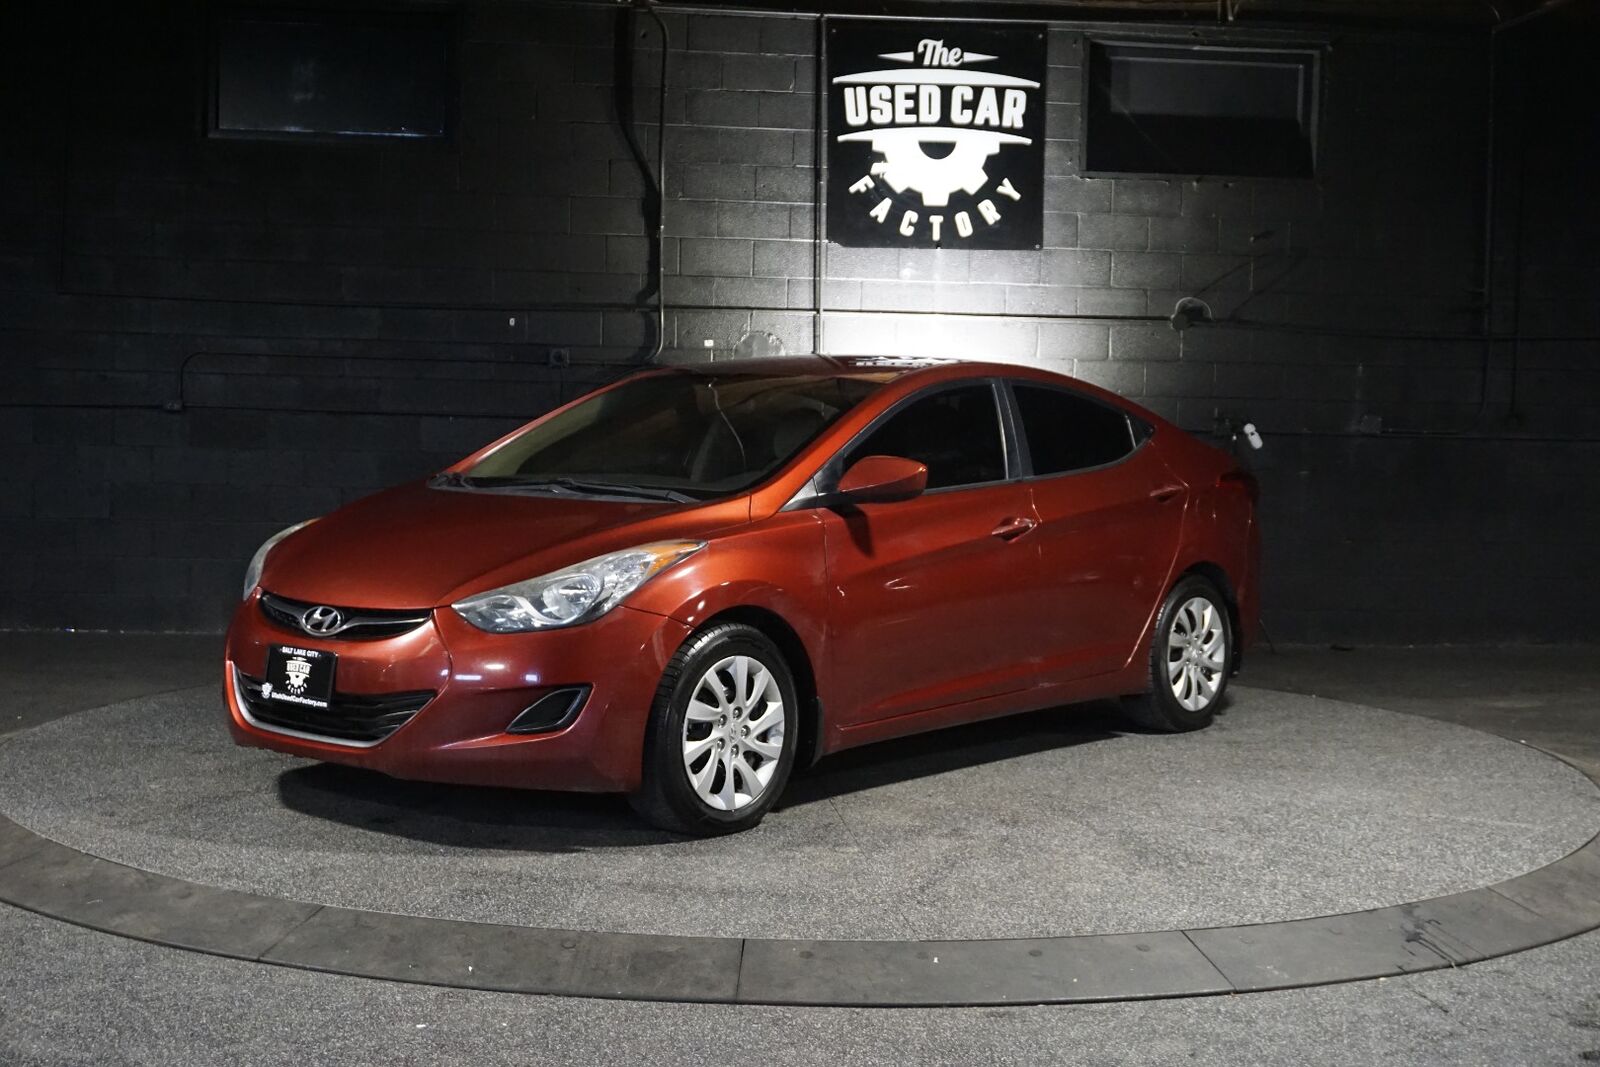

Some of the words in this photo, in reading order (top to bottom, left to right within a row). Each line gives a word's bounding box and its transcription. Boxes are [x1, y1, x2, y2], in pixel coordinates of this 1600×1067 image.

[917, 38, 964, 67] The
[844, 84, 942, 127] USED
[950, 85, 1027, 129] CAR
[848, 174, 1022, 242] FACTORY
